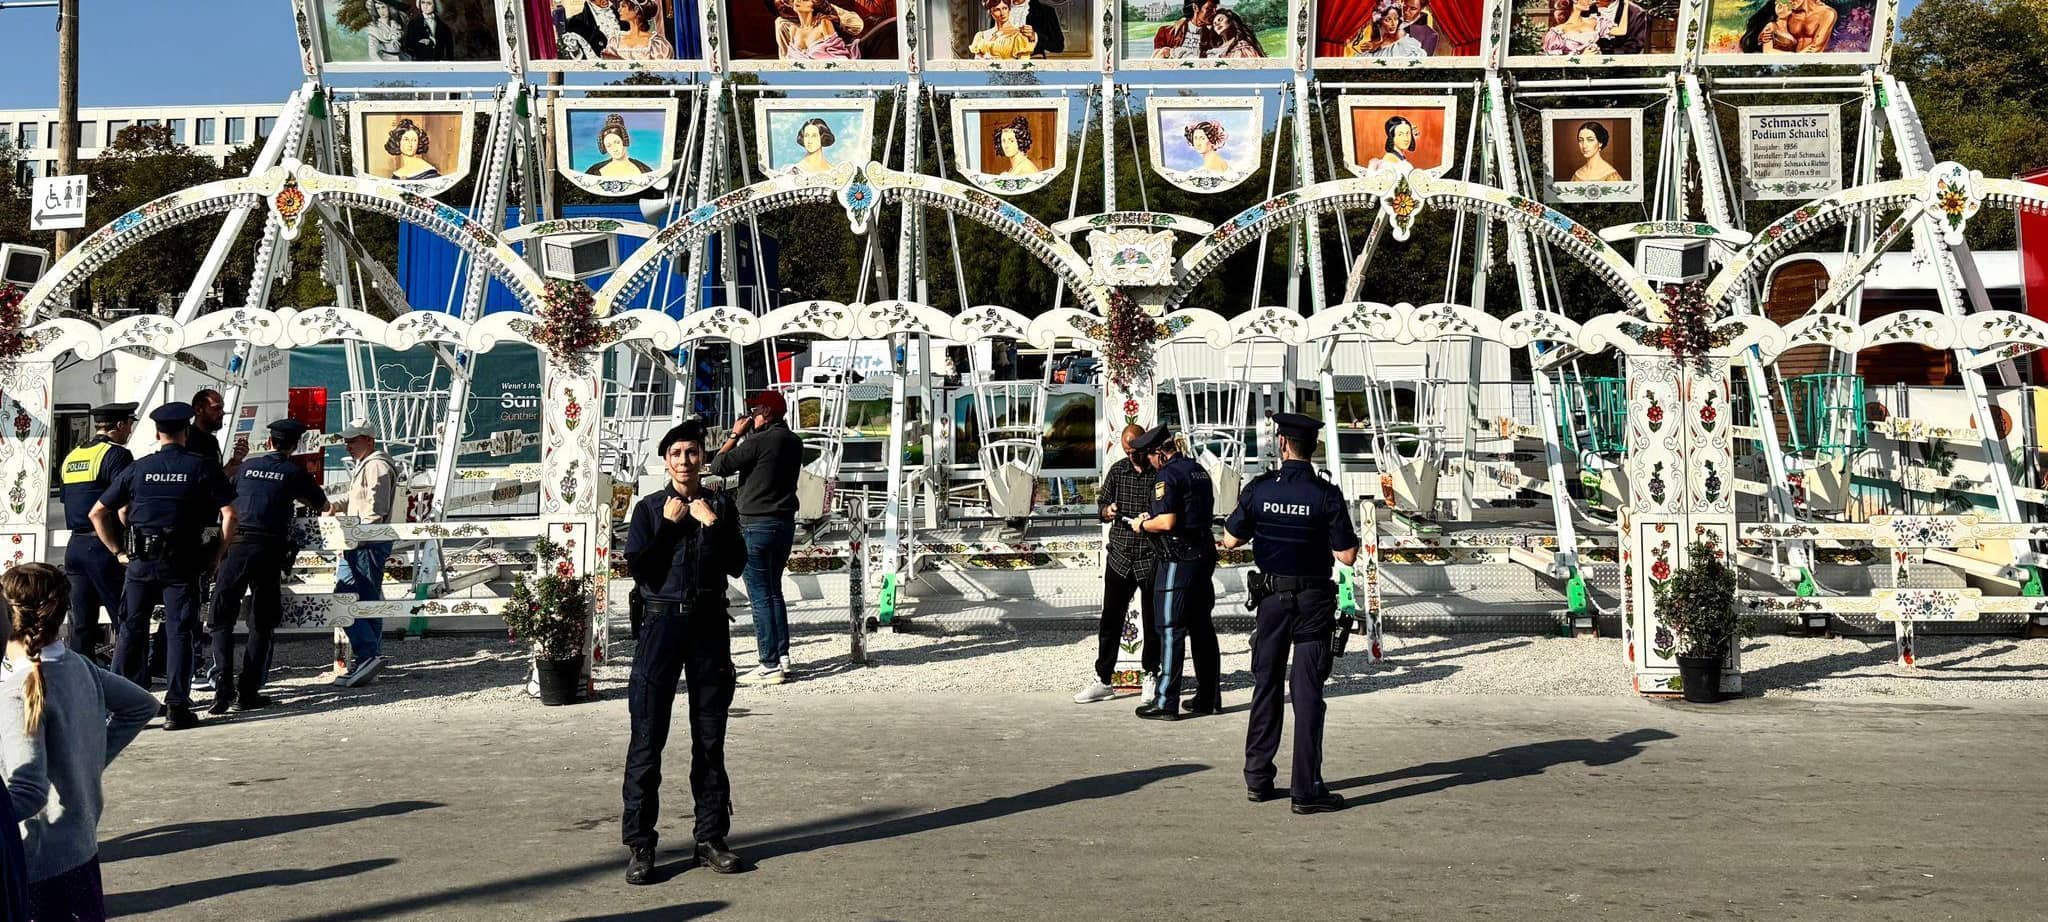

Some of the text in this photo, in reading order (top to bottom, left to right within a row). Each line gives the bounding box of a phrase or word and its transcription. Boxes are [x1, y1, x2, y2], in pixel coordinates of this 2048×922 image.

[1760, 117, 1817, 129] Schmack's
[1752, 128, 1828, 140] Podium Schaukel
[67, 462, 90, 472] POLIZEI
[145, 472, 187, 482] POLIZEI
[245, 469, 284, 481] POLIZEI
[1263, 501, 1310, 516] POLIZEI
